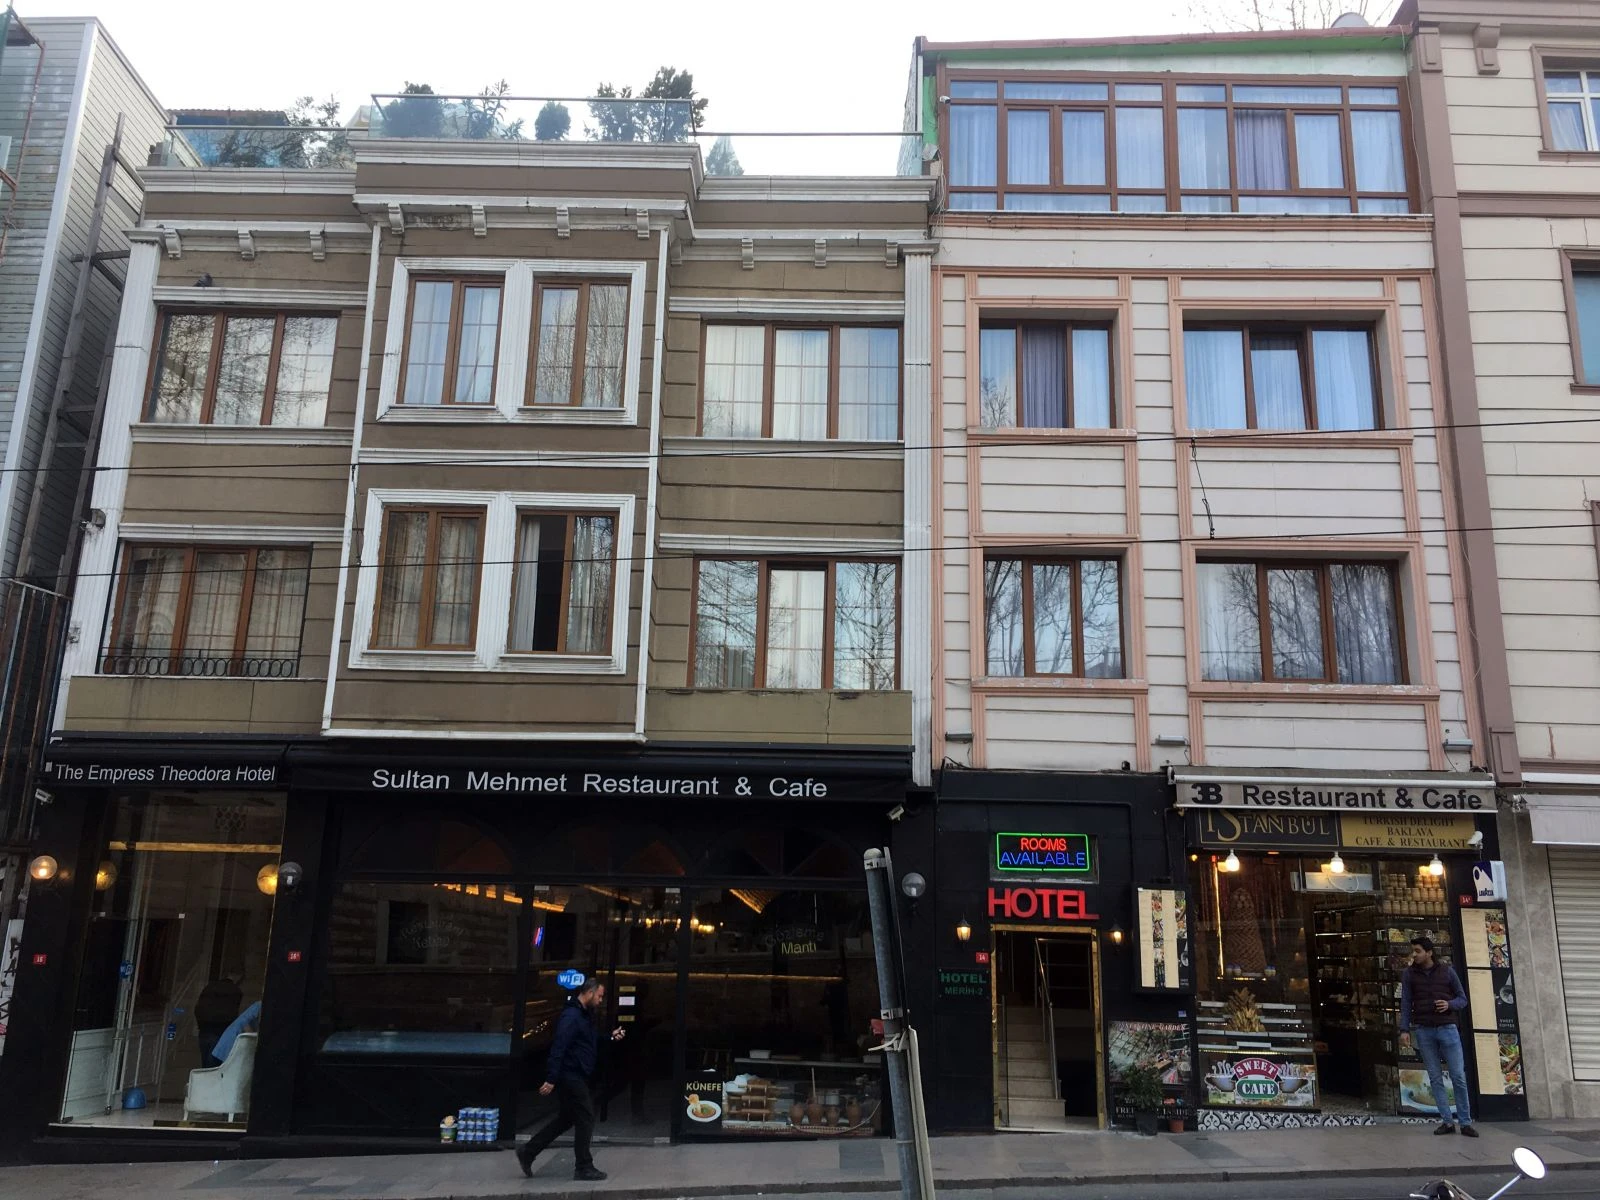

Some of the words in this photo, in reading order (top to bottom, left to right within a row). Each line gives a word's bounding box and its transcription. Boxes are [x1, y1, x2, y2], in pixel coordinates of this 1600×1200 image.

[55, 763, 84, 780] The
[88, 764, 154, 784] Empress
[159, 765, 231, 782] Theodora
[235, 766, 276, 782] Hotel
[371, 768, 450, 789] Sultan
[466, 770, 567, 792] Mehmet
[583, 773, 719, 795] Restaurant
[734, 776, 752, 796] &
[769, 777, 828, 797] Cafe
[1191, 782, 1223, 805] 3B
[1241, 784, 1386, 809] Restaurant
[1394, 787, 1415, 808] &
[1422, 787, 1483, 810] Cafe
[1363, 815, 1408, 826] TURKISH
[1409, 816, 1456, 827] DELIGHT
[1387, 827, 1434, 837] BAKLAVA
[1020, 837, 1067, 851] ROOMS
[1355, 836, 1383, 847] CAFE
[1387, 837, 1395, 847] &
[1400, 837, 1468, 848] RESTAURANT
[1000, 852, 1086, 866] AVAILABLE
[987, 887, 1100, 920] HOTEL
[940, 972, 987, 984] HOTEL
[1235, 1060, 1277, 1076] SWEET
[686, 1080, 722, 1091] KÜNEFE
[1241, 1082, 1275, 1095] CAFE
